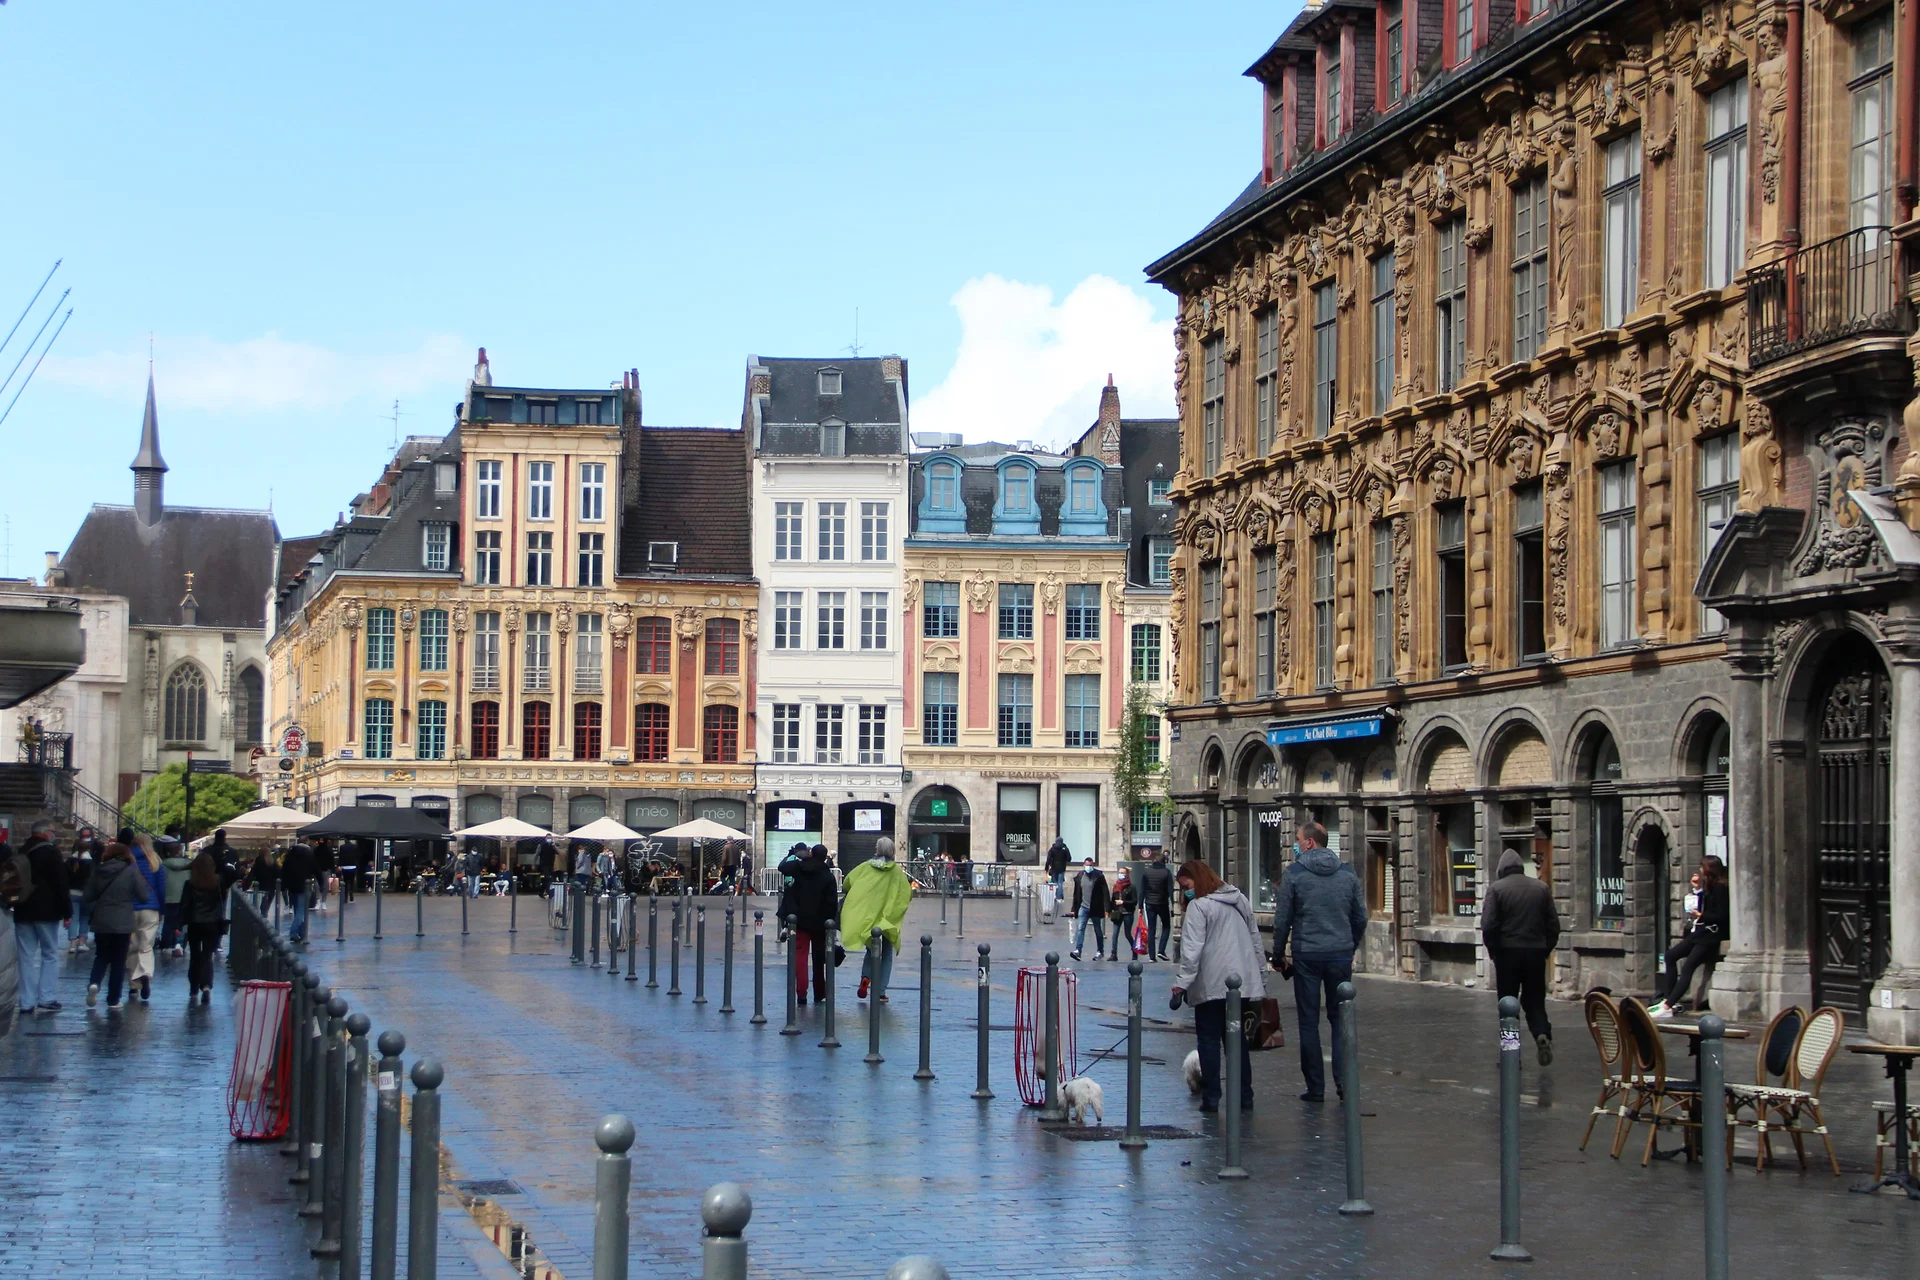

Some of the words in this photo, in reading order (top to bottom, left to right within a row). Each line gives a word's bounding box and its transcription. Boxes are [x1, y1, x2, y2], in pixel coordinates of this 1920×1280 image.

[1313, 727, 1325, 739] Chat
[1326, 726, 1338, 738] Bleu
[1008, 771, 1060, 779] PARIBAS
[1005, 833, 1031, 843] PROJETS
[1607, 877, 1626, 890] MAI
[1610, 892, 1625, 906] DO
